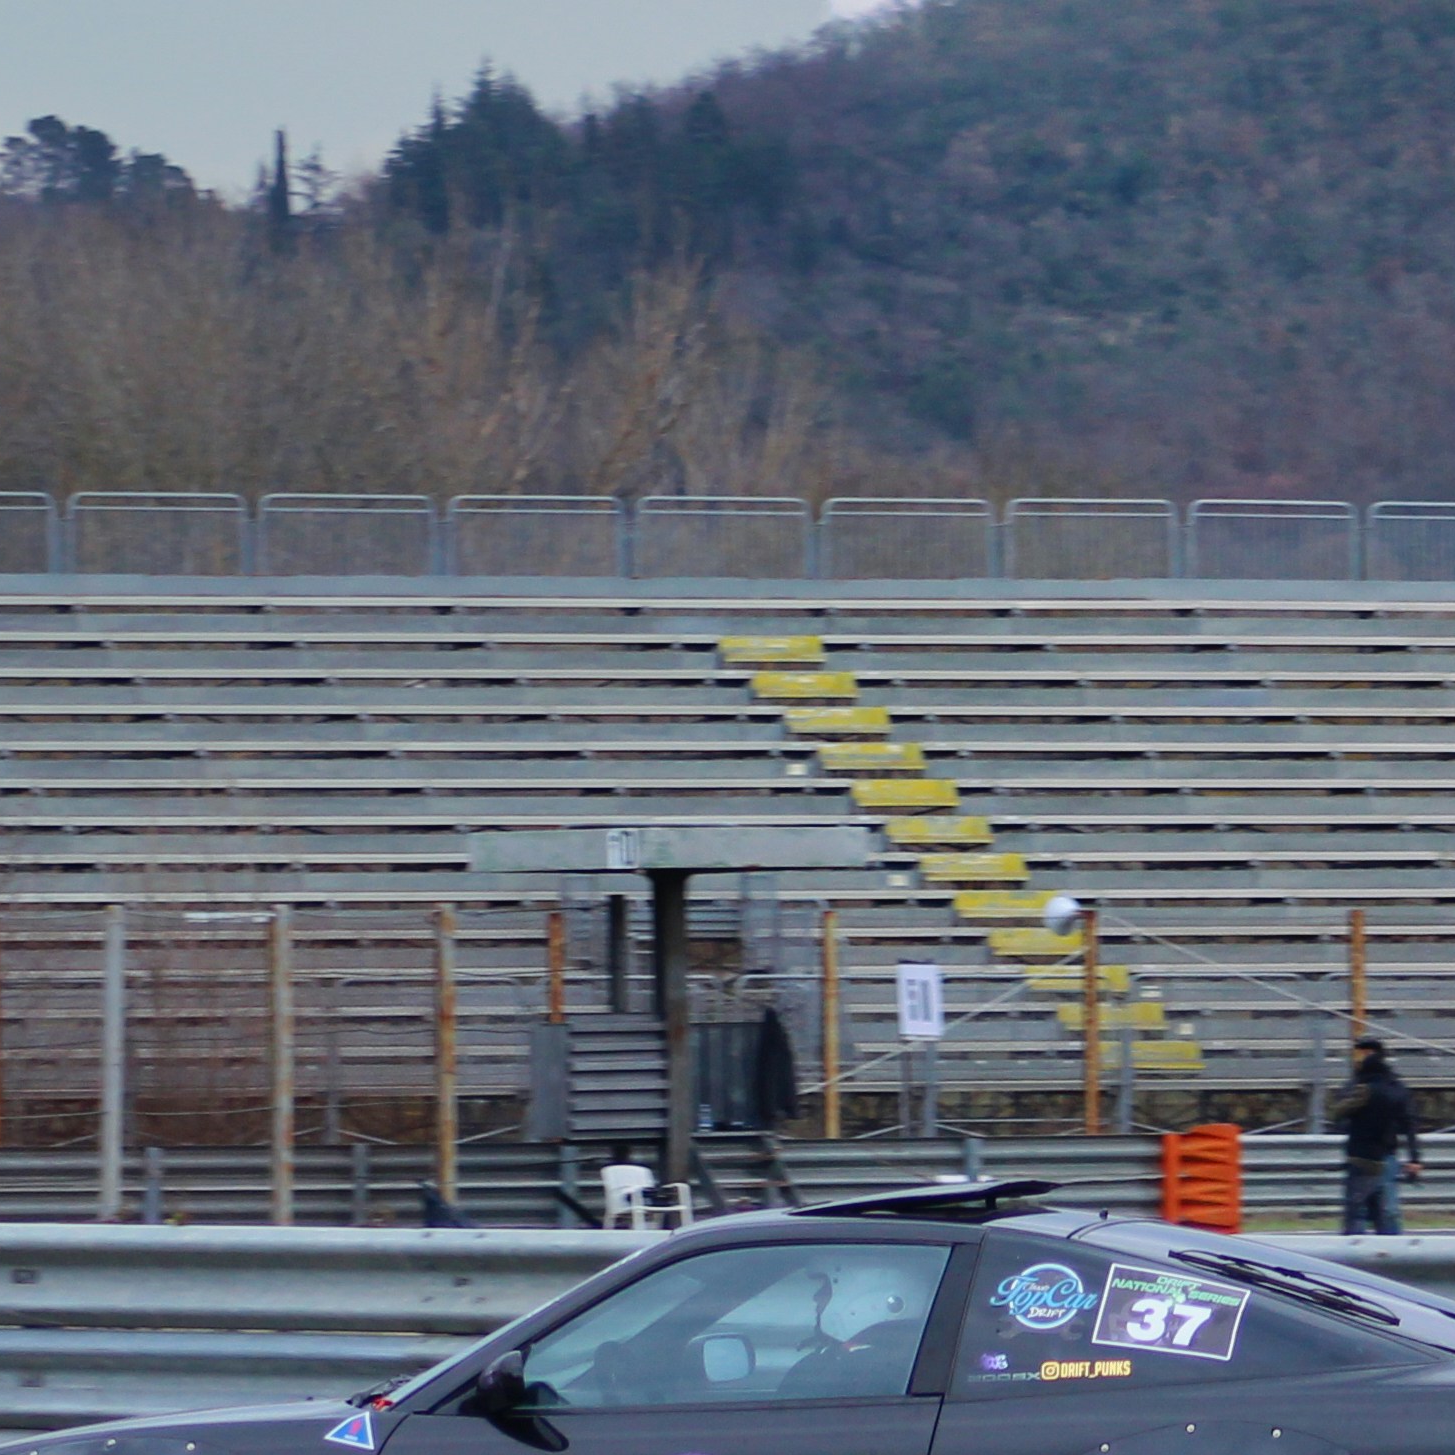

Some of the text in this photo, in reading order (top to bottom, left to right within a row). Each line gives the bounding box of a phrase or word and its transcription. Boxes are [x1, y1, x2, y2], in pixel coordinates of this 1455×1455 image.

[1112, 1278, 1242, 1306] NATIONAL SERIES
[1156, 1276, 1203, 1291] DRIFT
[1027, 1307, 1067, 1318] DRIFT
[1126, 1299, 1212, 1346] 37
[1060, 1361, 1131, 1379] DRIFT_PUNKS
